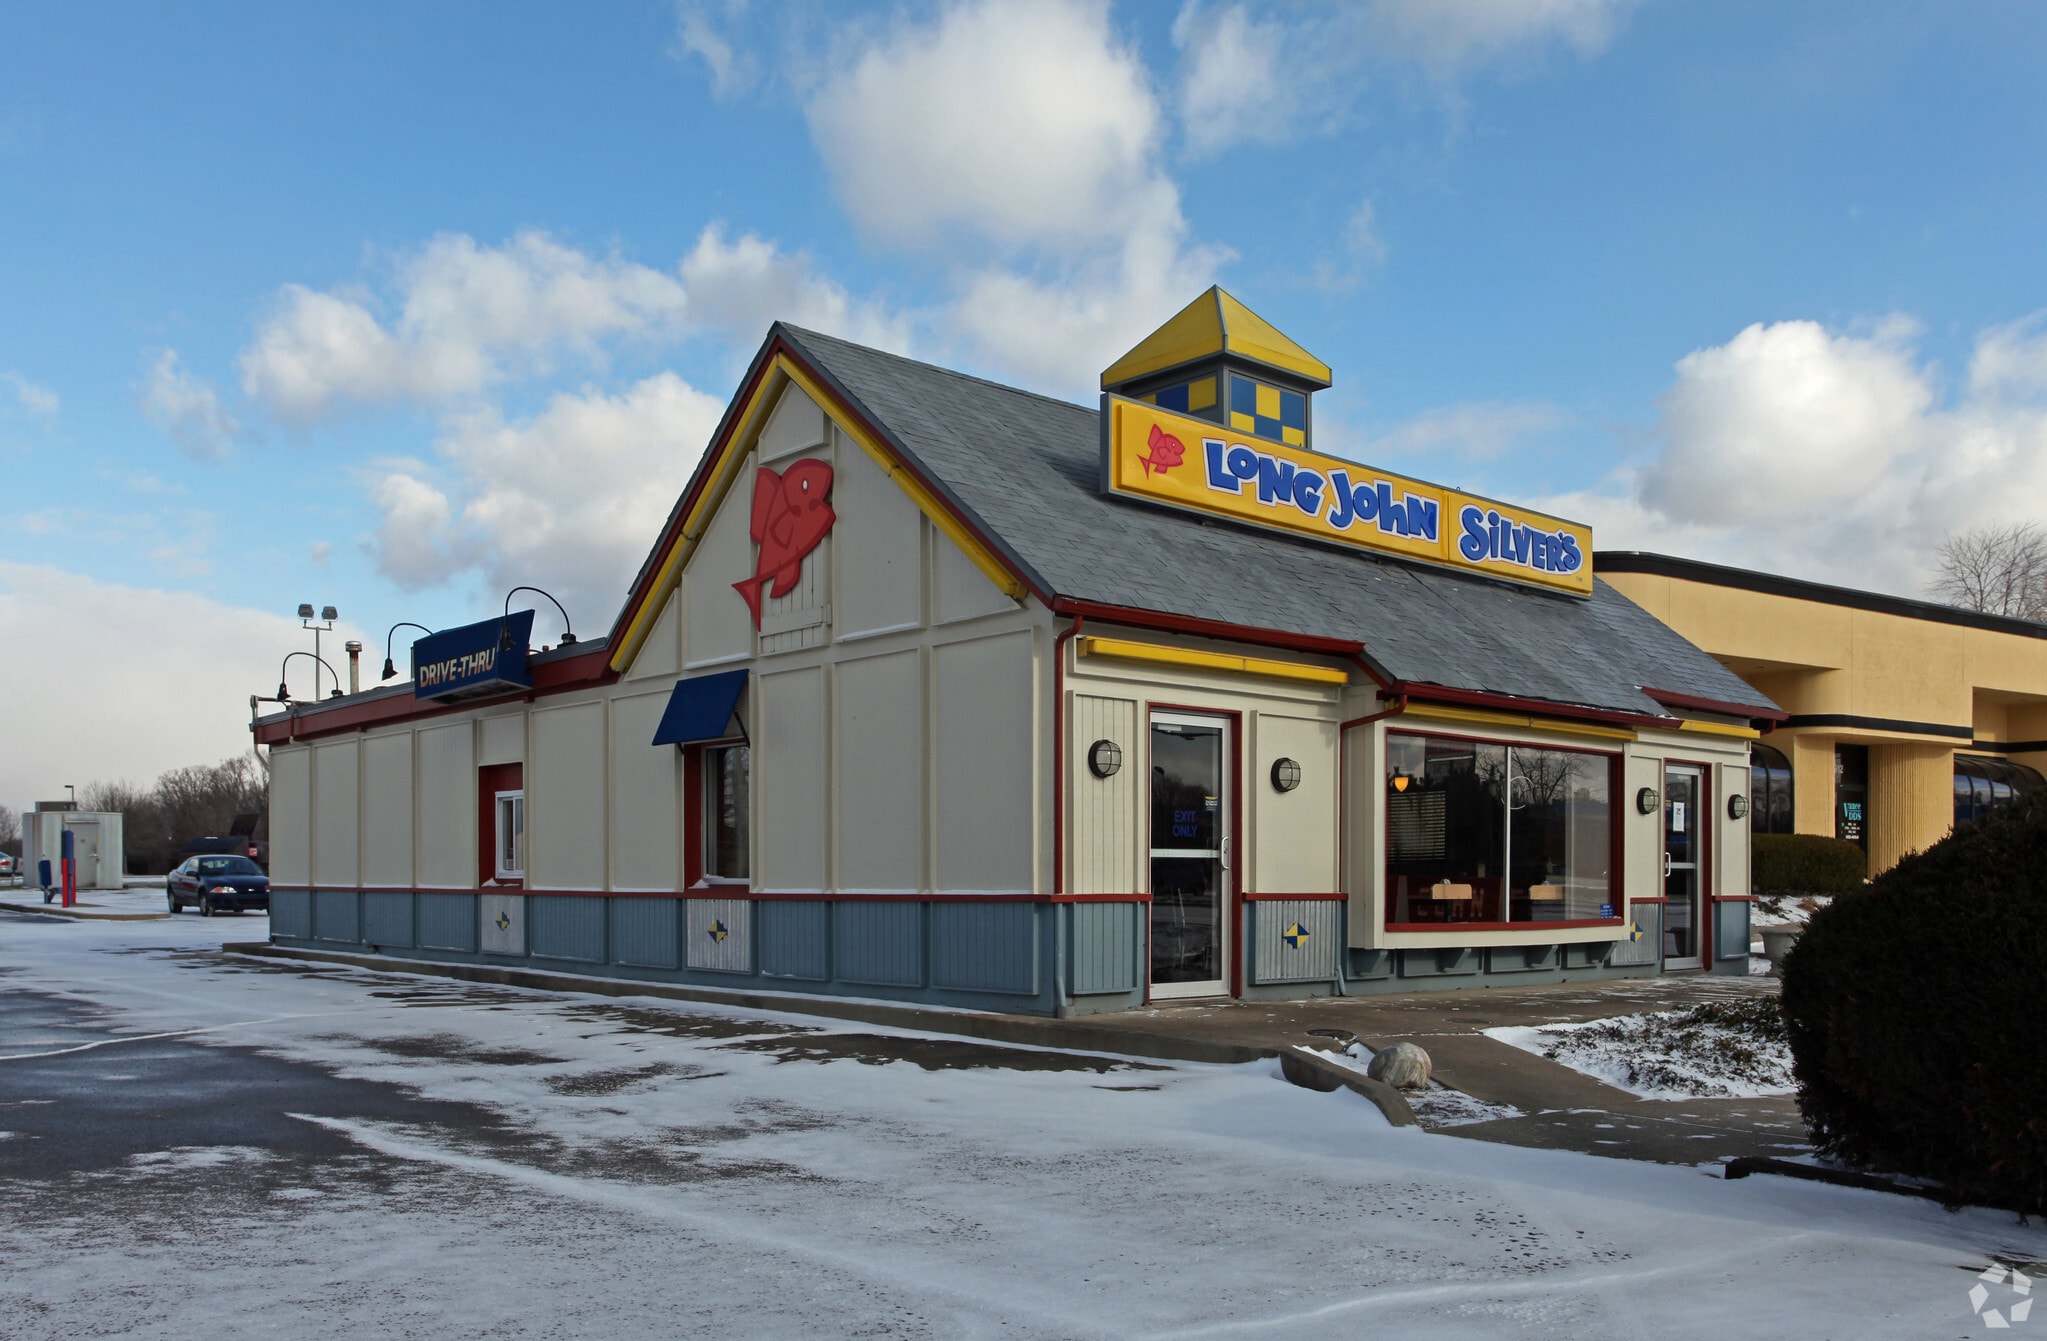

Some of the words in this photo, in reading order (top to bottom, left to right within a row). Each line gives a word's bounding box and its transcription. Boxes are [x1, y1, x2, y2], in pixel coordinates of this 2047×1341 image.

[1204, 440, 1325, 515] LONG
[419, 647, 496, 688] DRIVE-THRU
[1174, 810, 1197, 823] EXIT
[1172, 825, 1198, 837] ONLY
